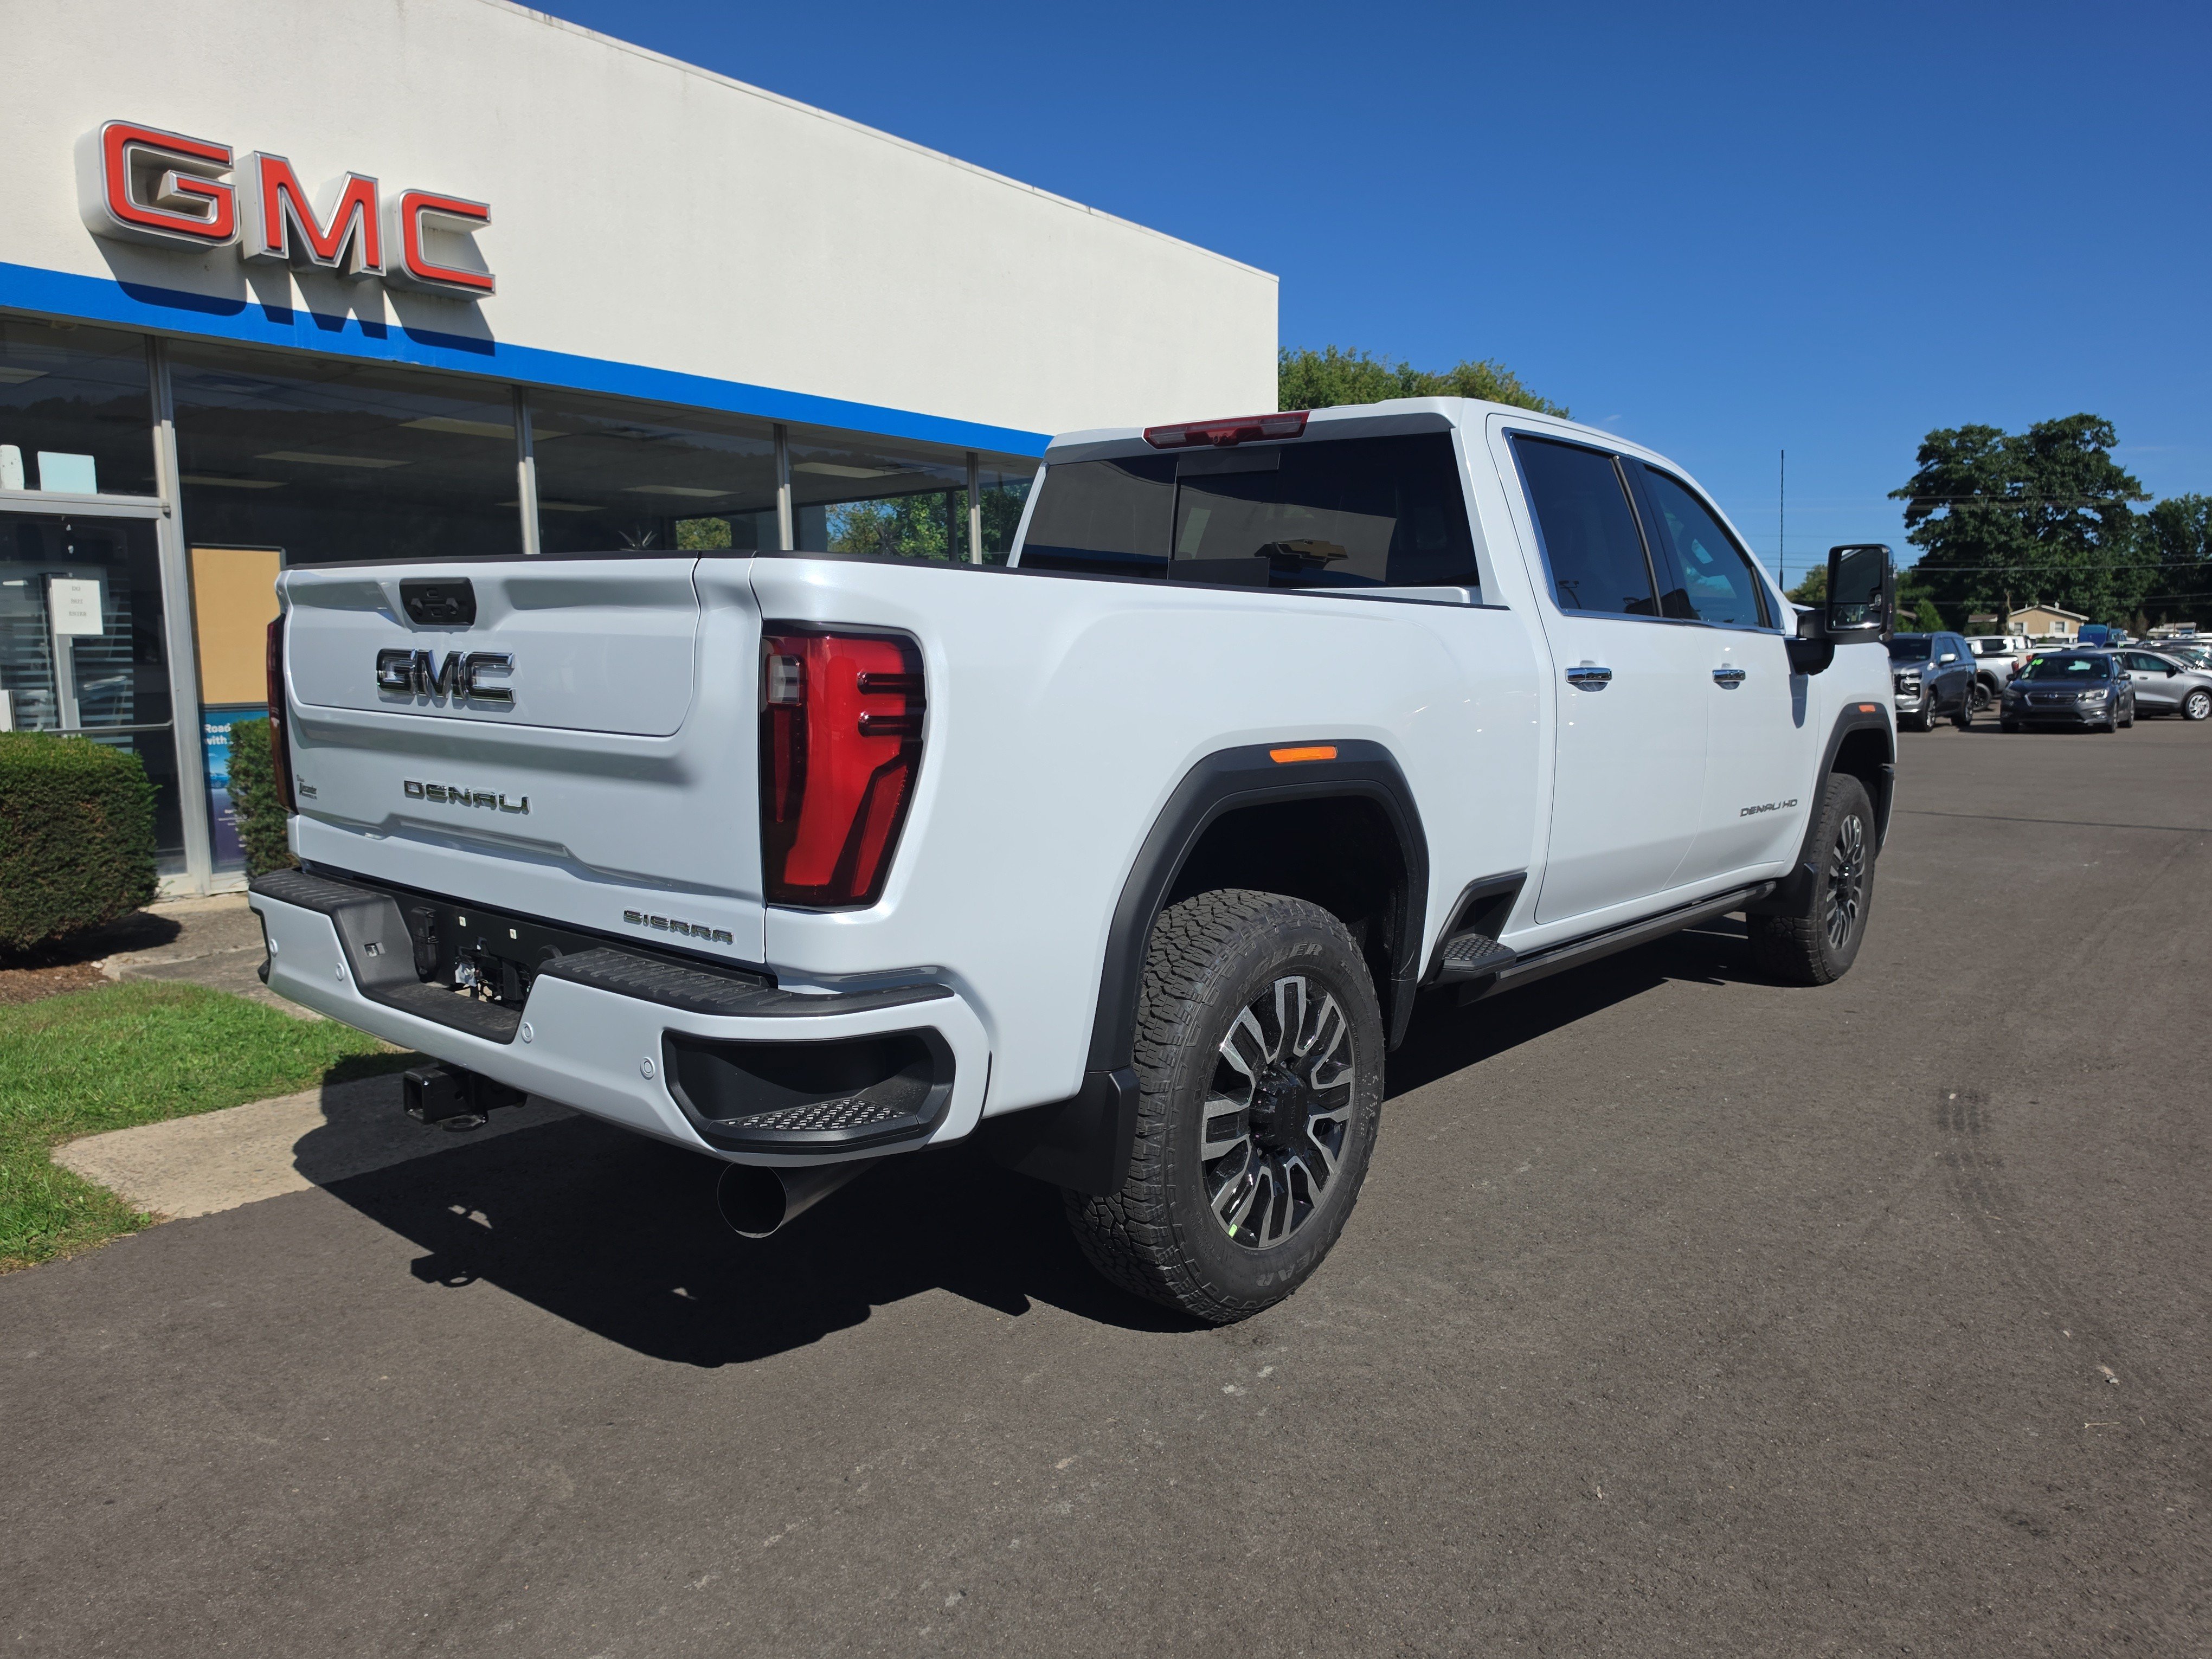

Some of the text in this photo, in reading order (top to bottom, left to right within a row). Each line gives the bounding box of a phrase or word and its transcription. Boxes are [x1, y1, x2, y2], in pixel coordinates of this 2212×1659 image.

[98, 119, 496, 297] GMC
[376, 648, 517, 704] GMC
[204, 723, 232, 734] Road
[403, 779, 531, 814] DENALI
[1740, 799, 1798, 817] DENALI HD
[623, 910, 735, 943] SIERRA
